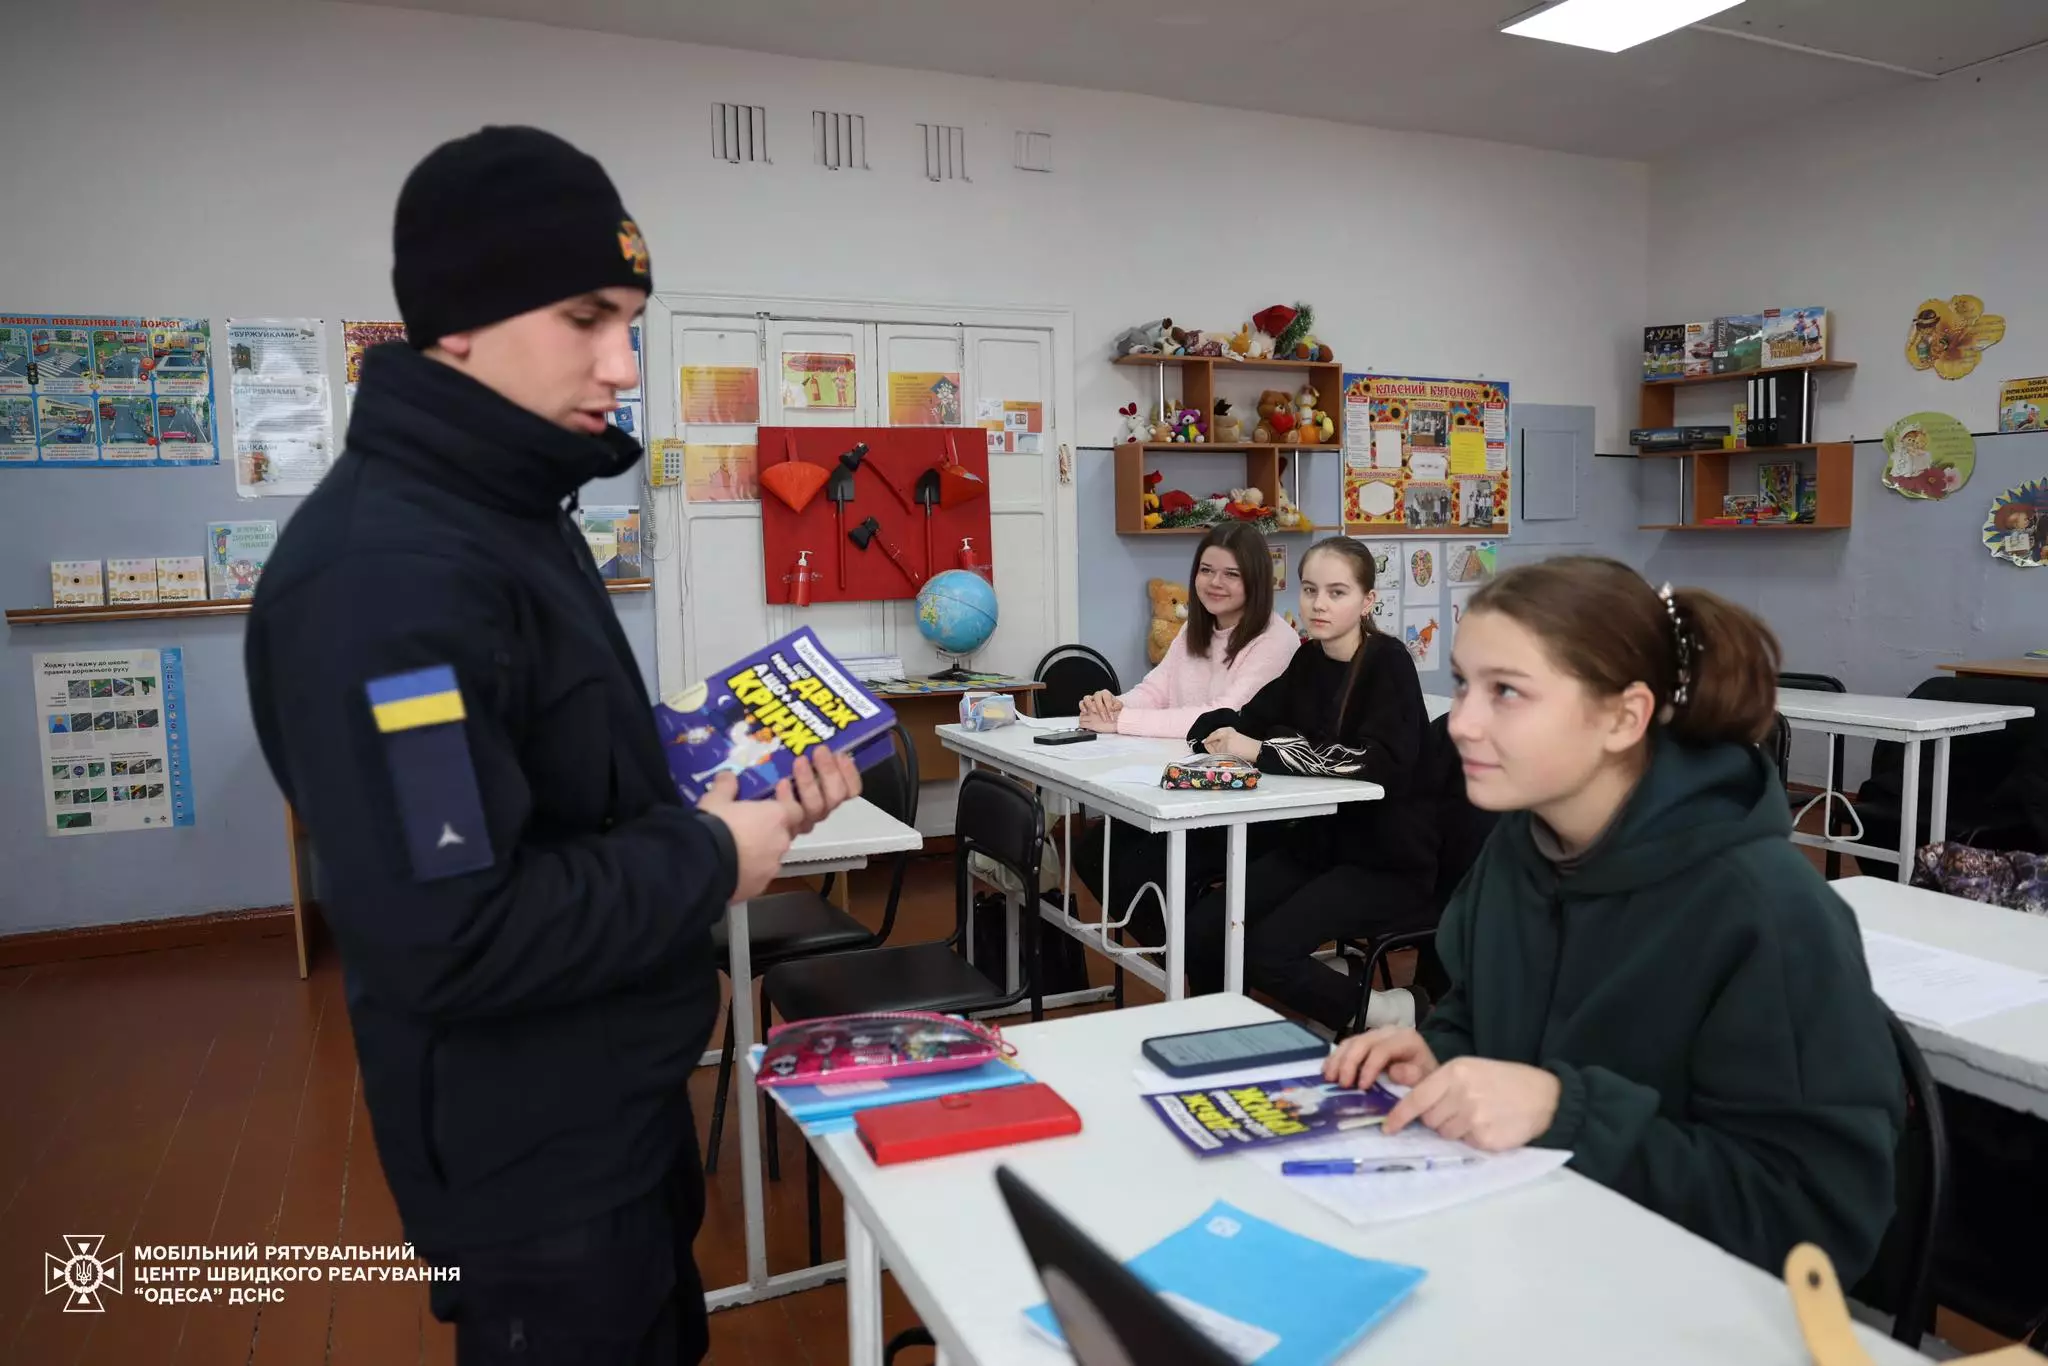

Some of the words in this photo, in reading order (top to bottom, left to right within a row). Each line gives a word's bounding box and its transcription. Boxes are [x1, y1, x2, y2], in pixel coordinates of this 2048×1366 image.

[0, 317, 48, 325] РАВИЛА
[52, 318, 118, 328] ПОВЕДІНКИ
[1376, 382, 1425, 395] КЛАСНИЙ
[1430, 385, 1478, 399] КУТОЧОК
[43, 661, 67, 669] Ходжу
[113, 666, 130, 674] руху
[727, 667, 824, 757] КРІНЖ
